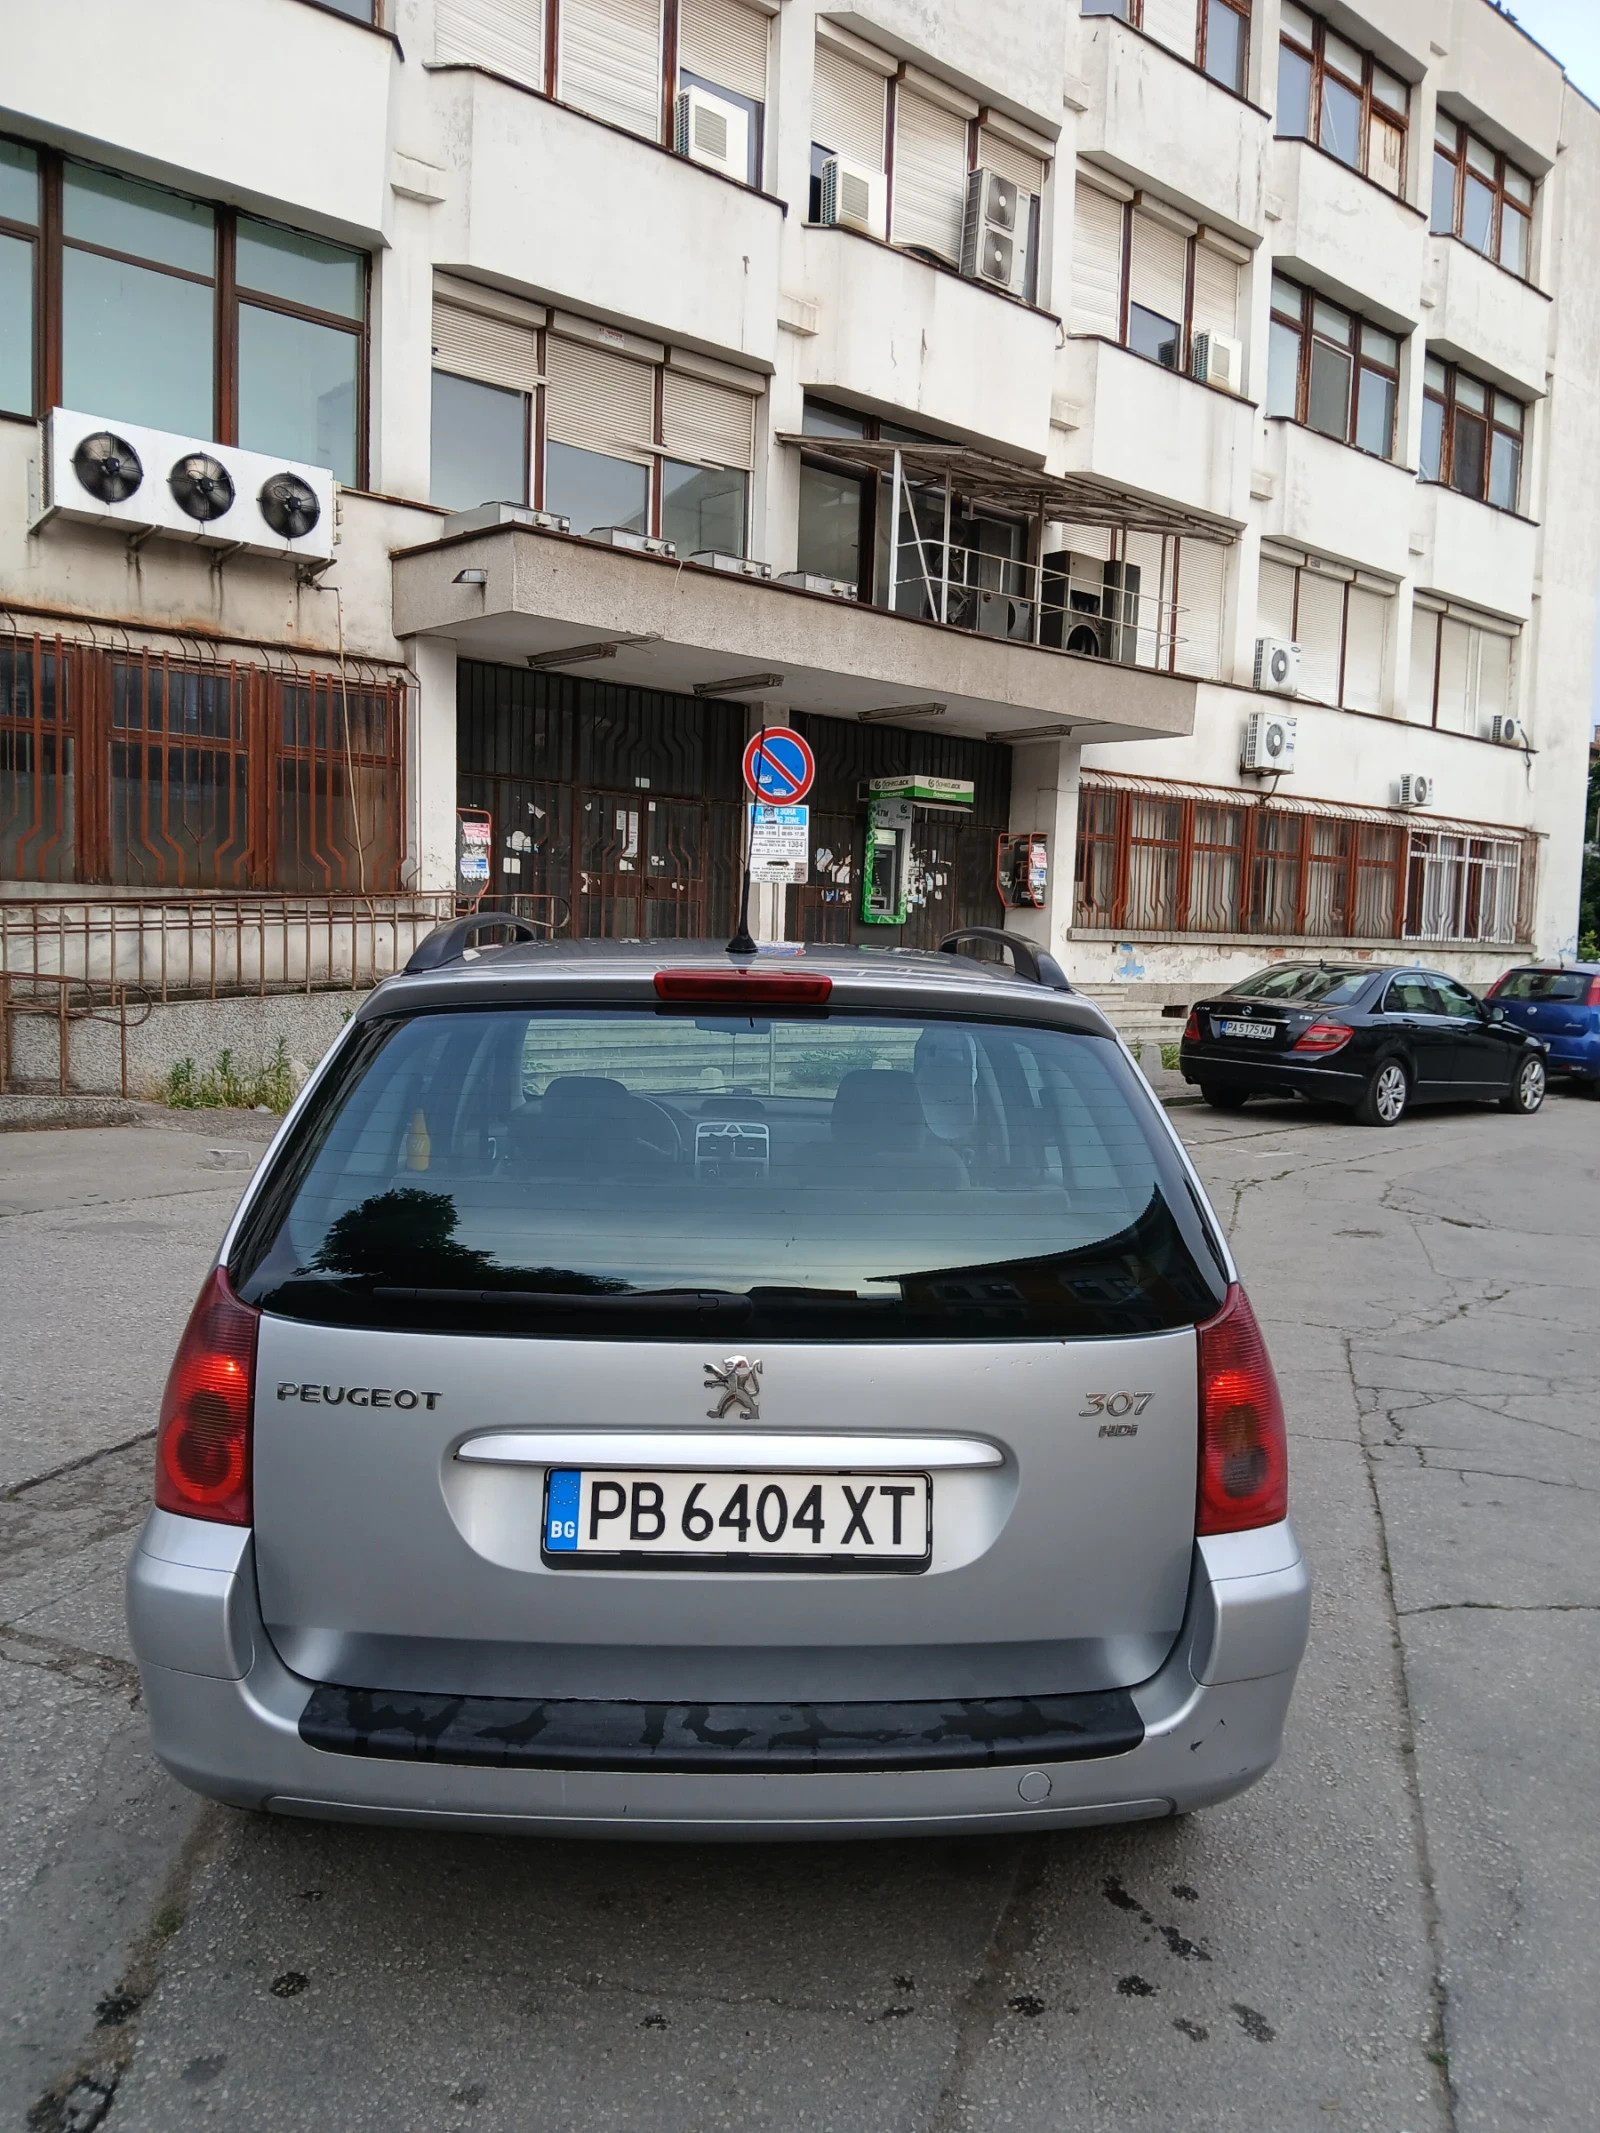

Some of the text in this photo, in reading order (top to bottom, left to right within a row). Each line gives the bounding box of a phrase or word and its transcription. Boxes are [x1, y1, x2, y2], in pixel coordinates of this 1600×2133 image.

[784, 816, 801, 824] ZONE
[876, 809, 889, 817] ATM
[276, 1380, 443, 1411] PEUGEOT
[1078, 1389, 1155, 1417] 307
[588, 1480, 916, 1545] PB 6404 XT
[550, 1520, 576, 1540] BG
